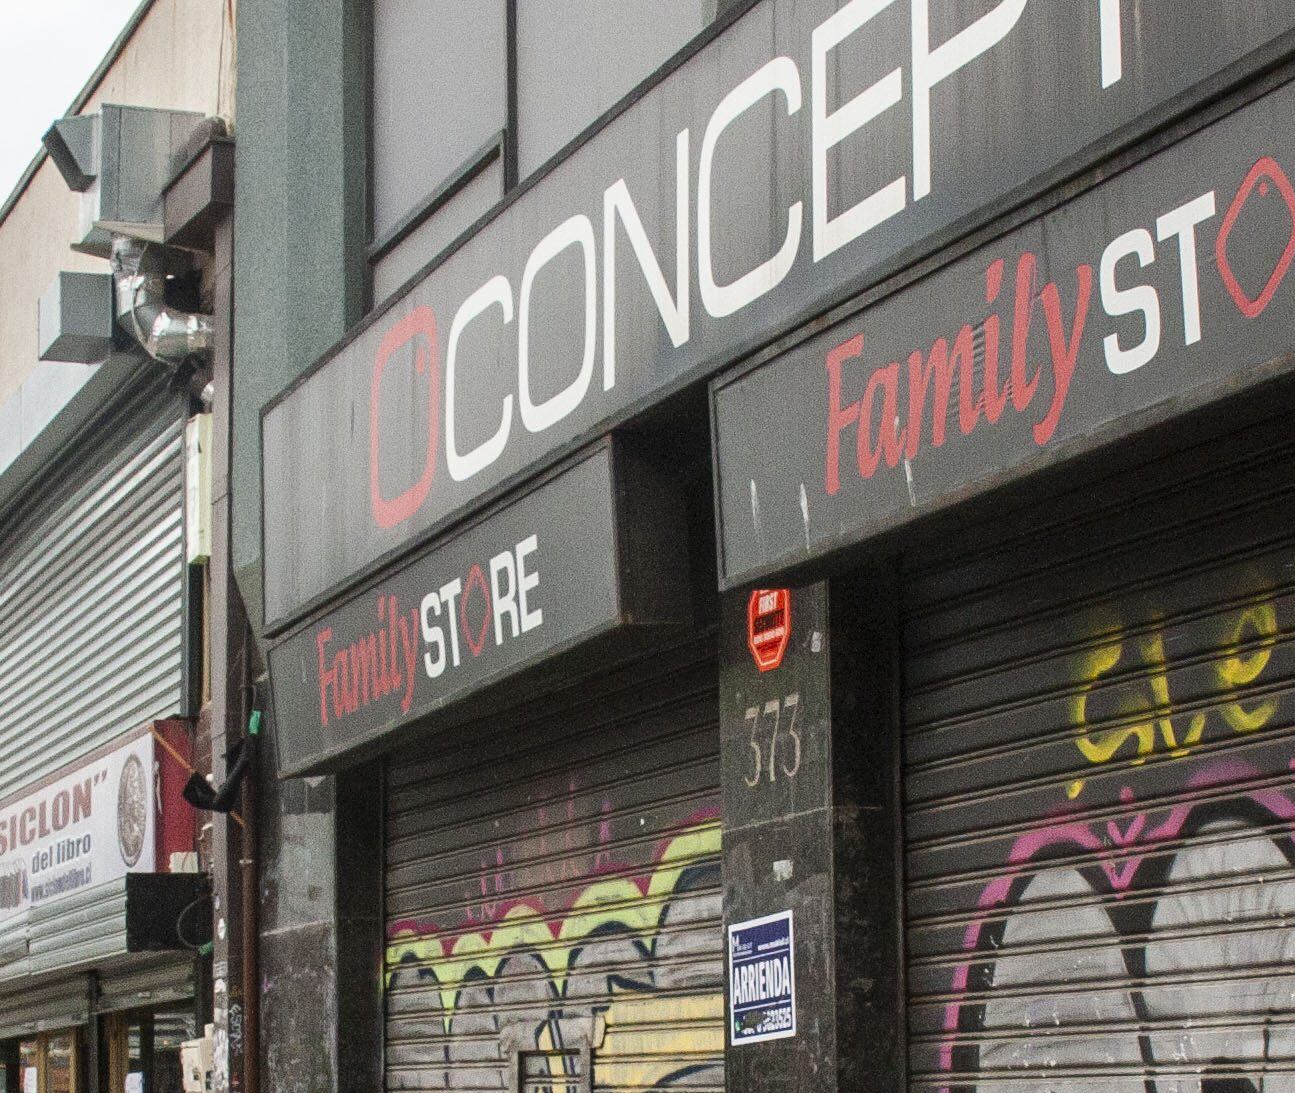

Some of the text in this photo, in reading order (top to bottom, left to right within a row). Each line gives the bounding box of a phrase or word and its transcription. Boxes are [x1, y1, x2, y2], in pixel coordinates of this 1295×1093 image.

[826, 252, 1093, 495] Family
[316, 534, 543, 727] Family STORE
[743, 691, 801, 788] 373
[32, 834, 91, 874] del libro
[733, 955, 791, 1005] ARRIENDA
